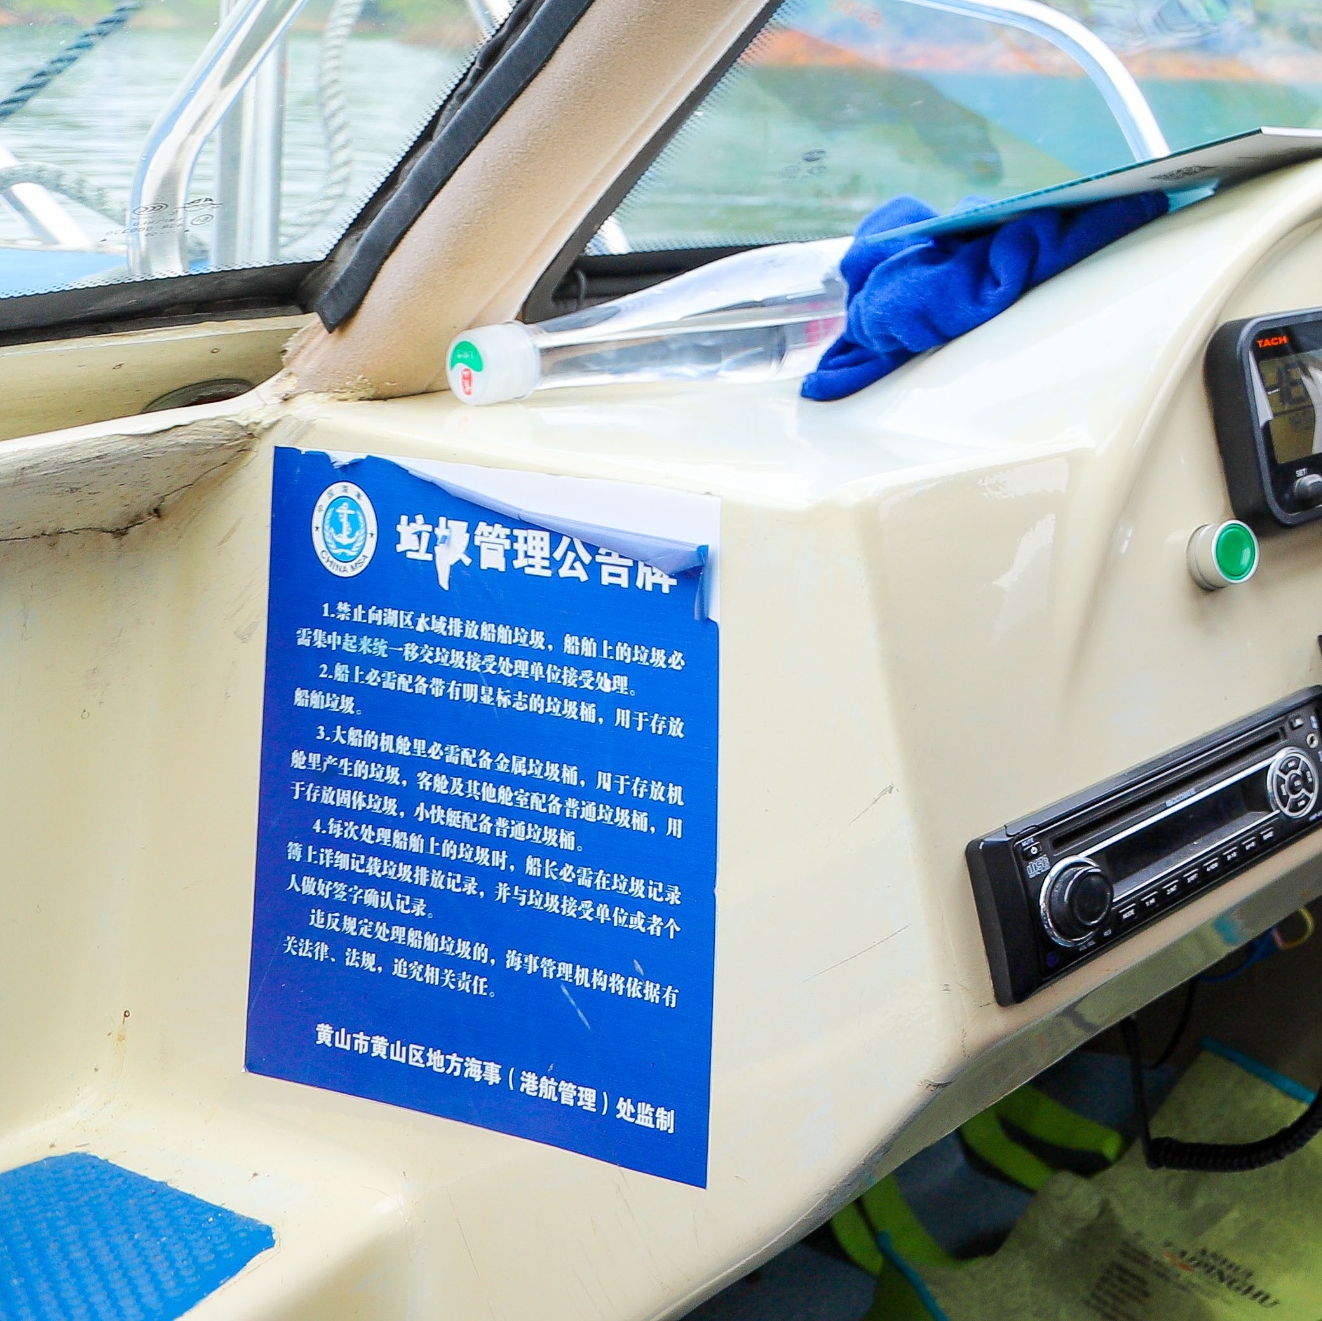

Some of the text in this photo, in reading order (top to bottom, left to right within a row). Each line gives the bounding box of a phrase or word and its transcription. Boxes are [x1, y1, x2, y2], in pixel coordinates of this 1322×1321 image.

[1257, 336, 1289, 348] TACH
[1295, 468, 1308, 478] SET
[320, 549, 369, 573] CHINA MSA
[293, 687, 363, 716] 船舶垃圾。
